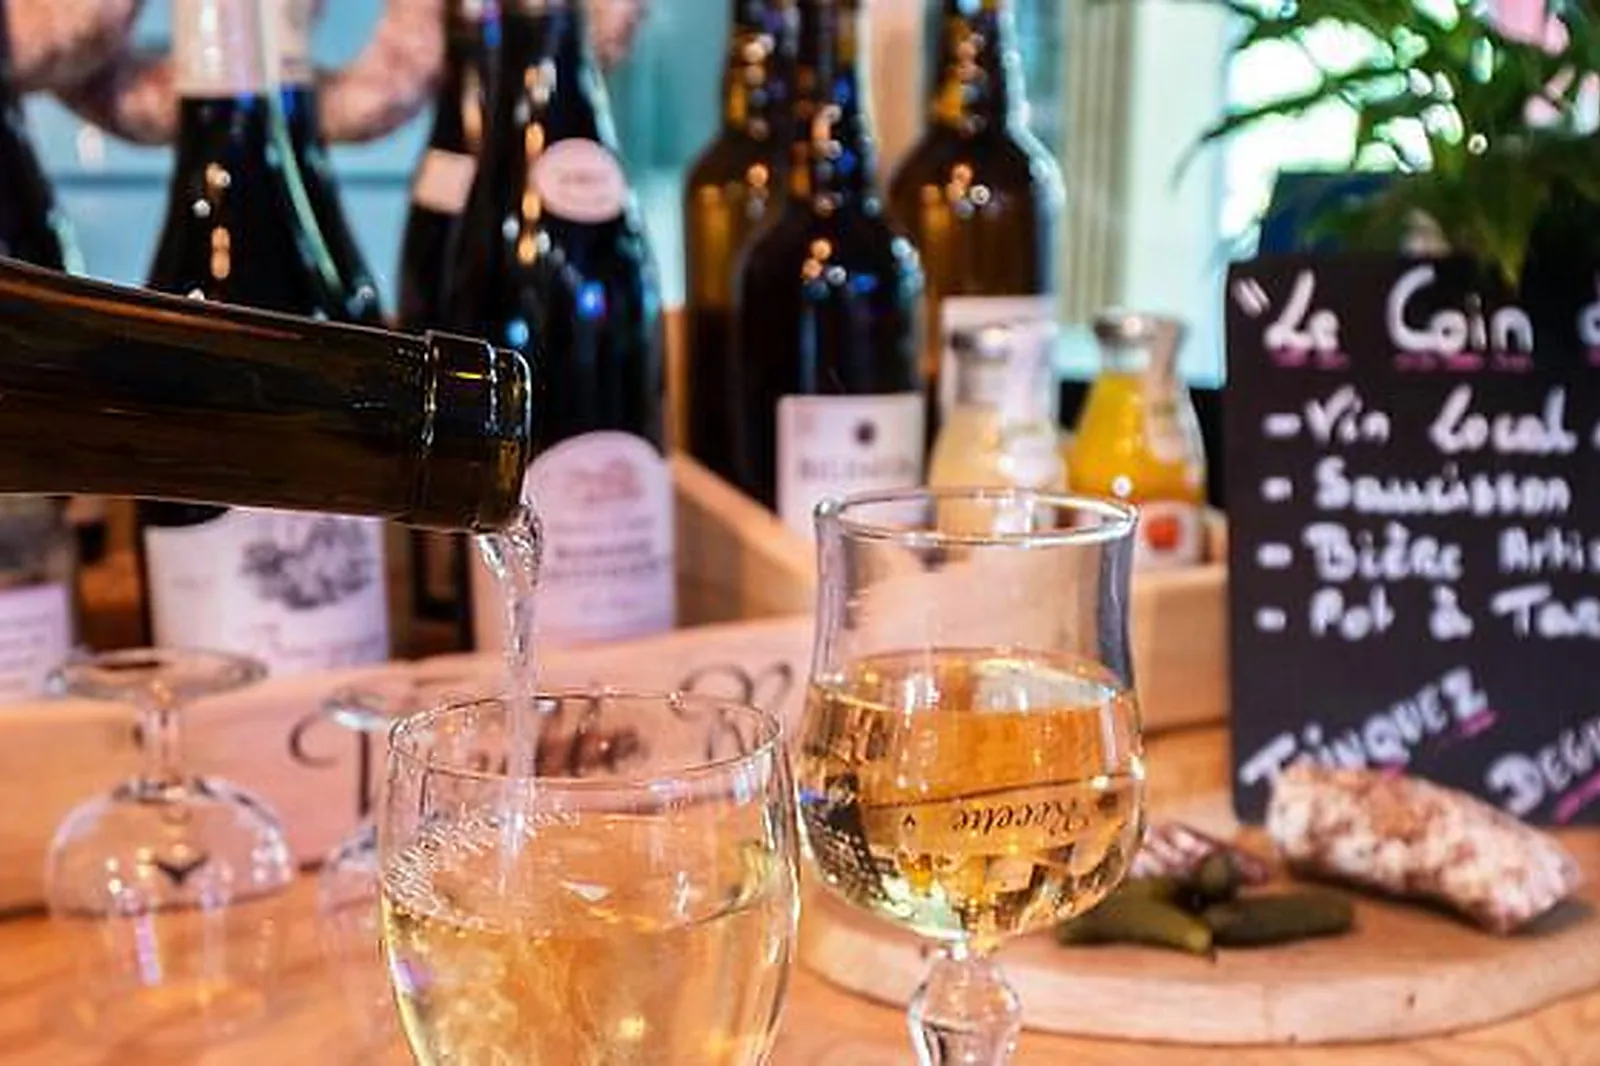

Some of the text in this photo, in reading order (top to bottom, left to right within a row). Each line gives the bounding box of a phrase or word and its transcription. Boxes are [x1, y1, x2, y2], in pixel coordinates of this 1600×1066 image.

[1386, 264, 1534, 356] Coin
[1313, 456, 1571, 517] Saucisson
[1309, 586, 1394, 640] Pot
